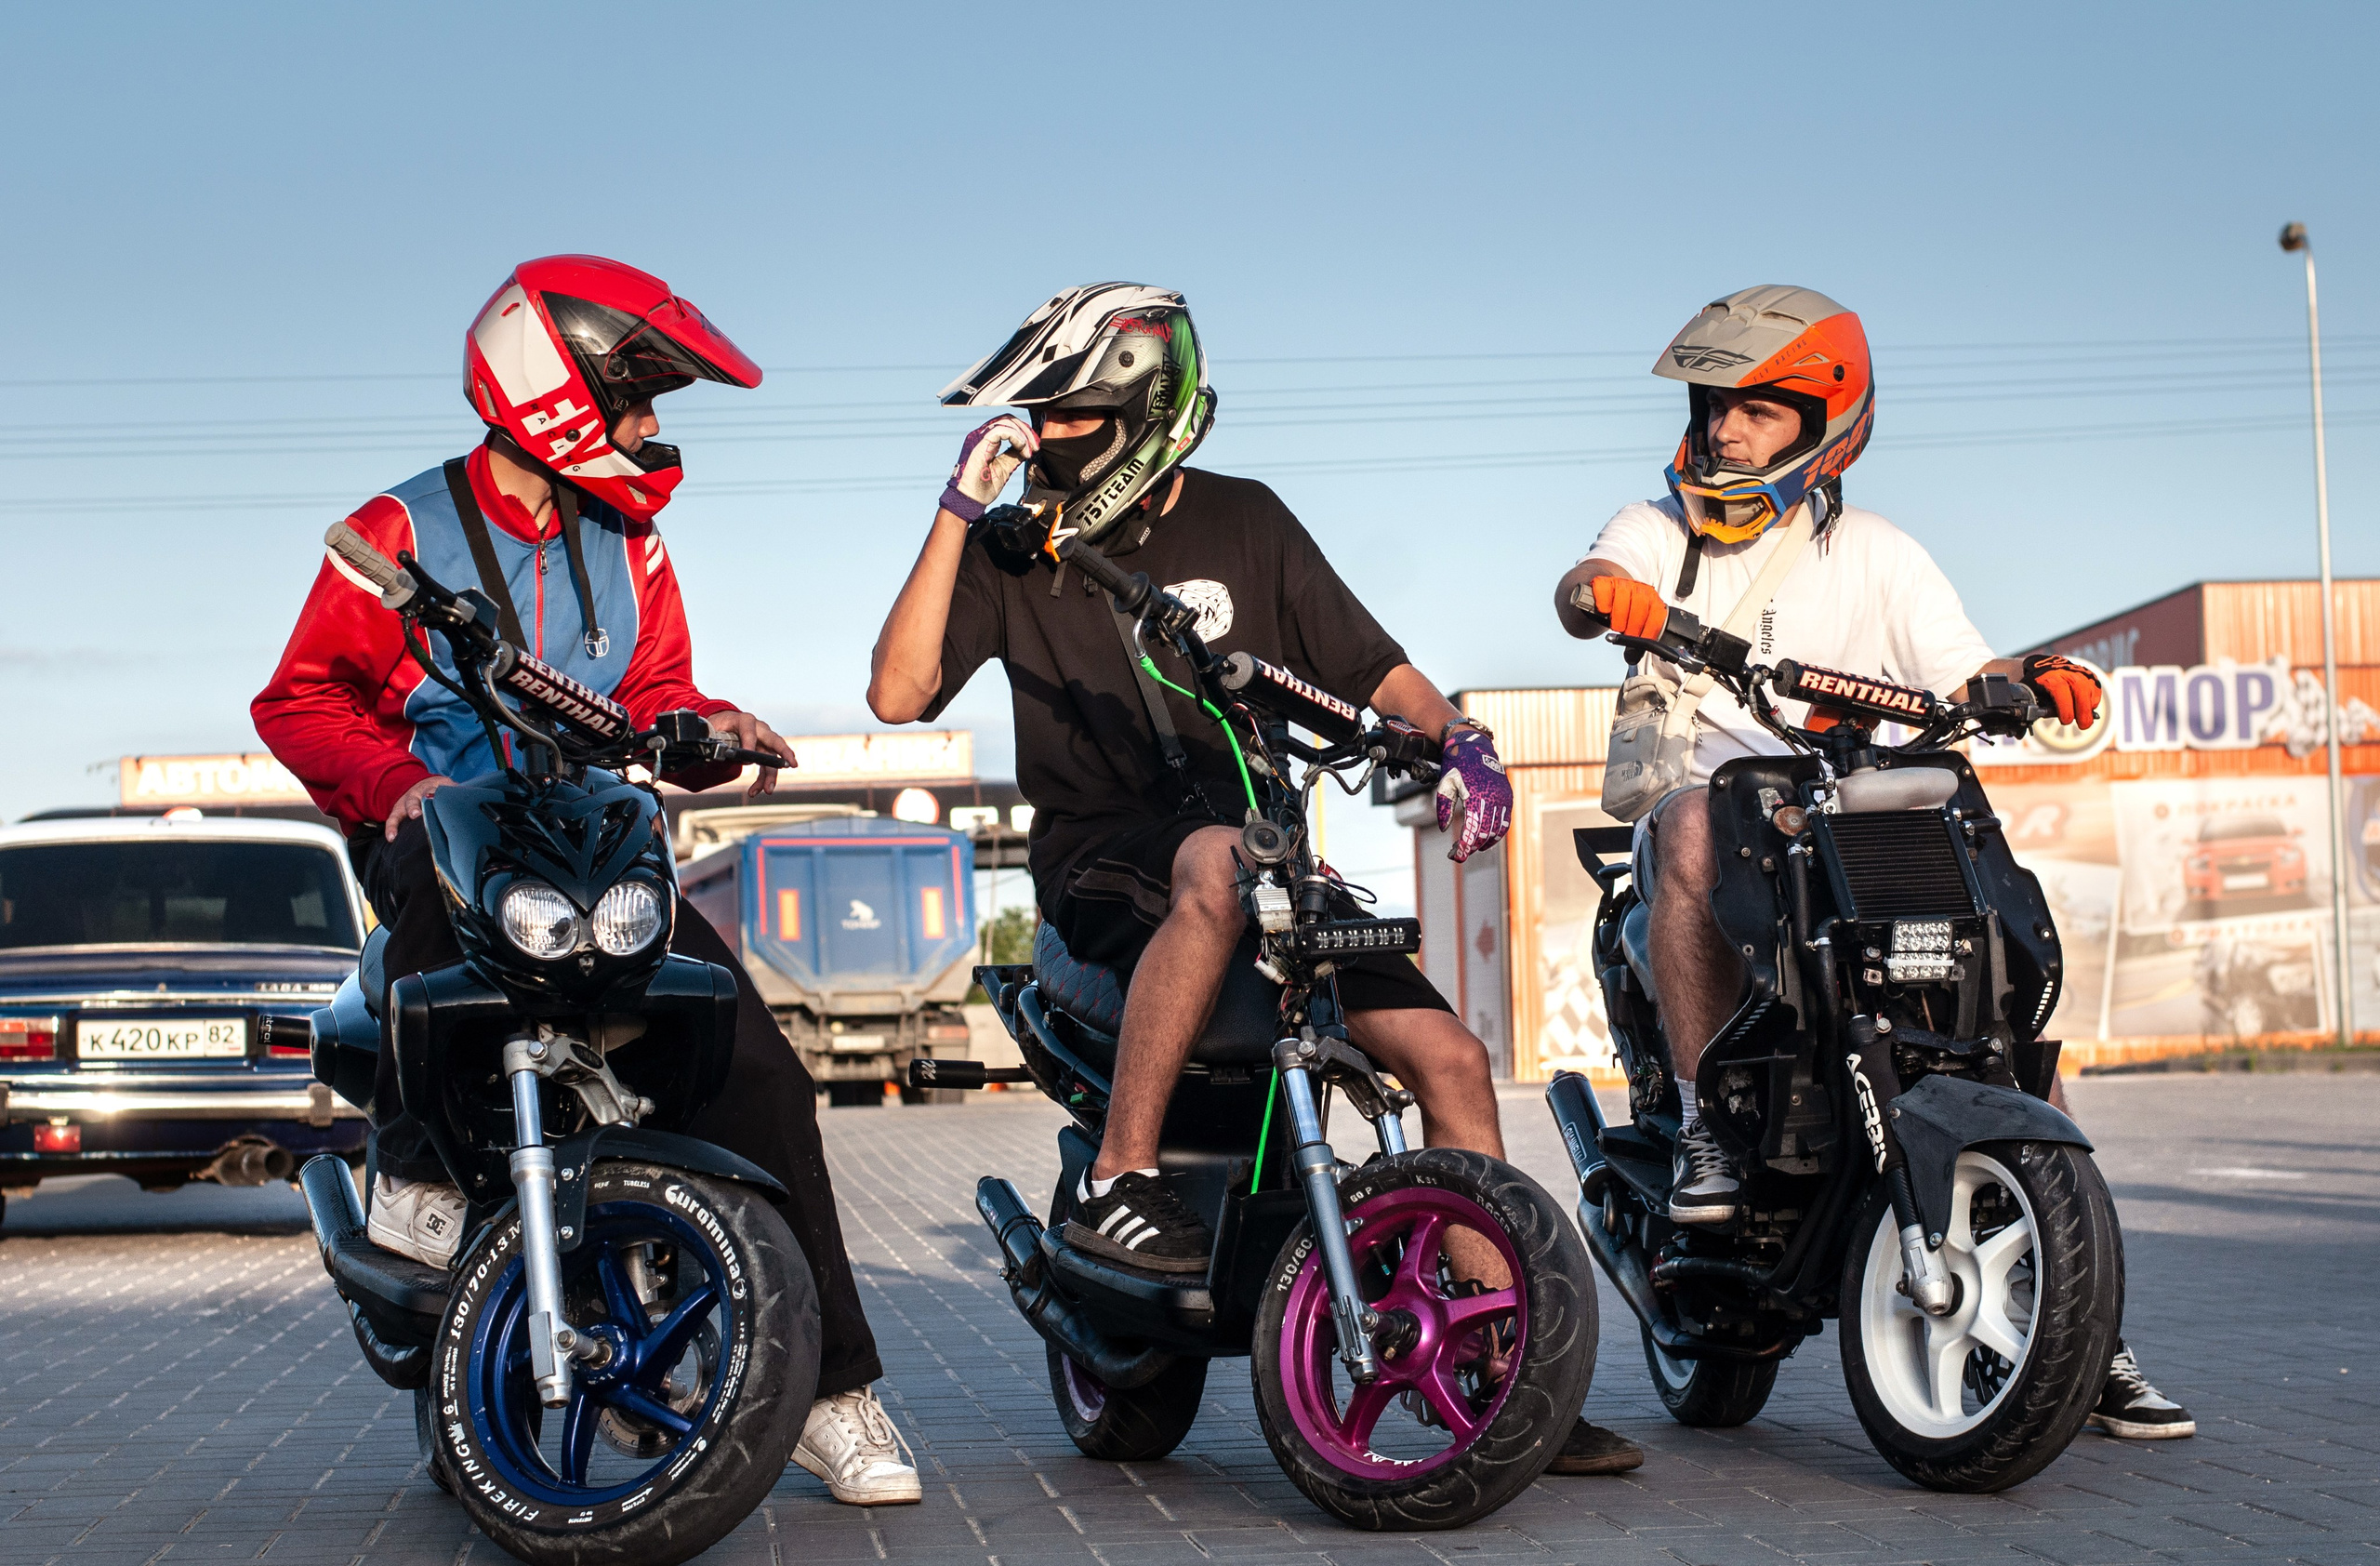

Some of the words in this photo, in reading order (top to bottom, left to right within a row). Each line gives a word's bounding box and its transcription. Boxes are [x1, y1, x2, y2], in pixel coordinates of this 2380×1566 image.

[529, 403, 581, 472] RACING
[1138, 526, 1151, 547] MOTO
[509, 669, 617, 737] RENTHAL
[518, 650, 623, 720] RENTHAL
[1256, 658, 1356, 722] RENTHAL
[1798, 670, 1928, 715] RENTHAL
[137, 759, 306, 797] АВТОМ
[207, 1025, 235, 1043] 82
[1474, 1191, 1512, 1235] RACER
[450, 1236, 509, 1340] 130/70-13
[455, 1443, 539, 1521] FIREKING
